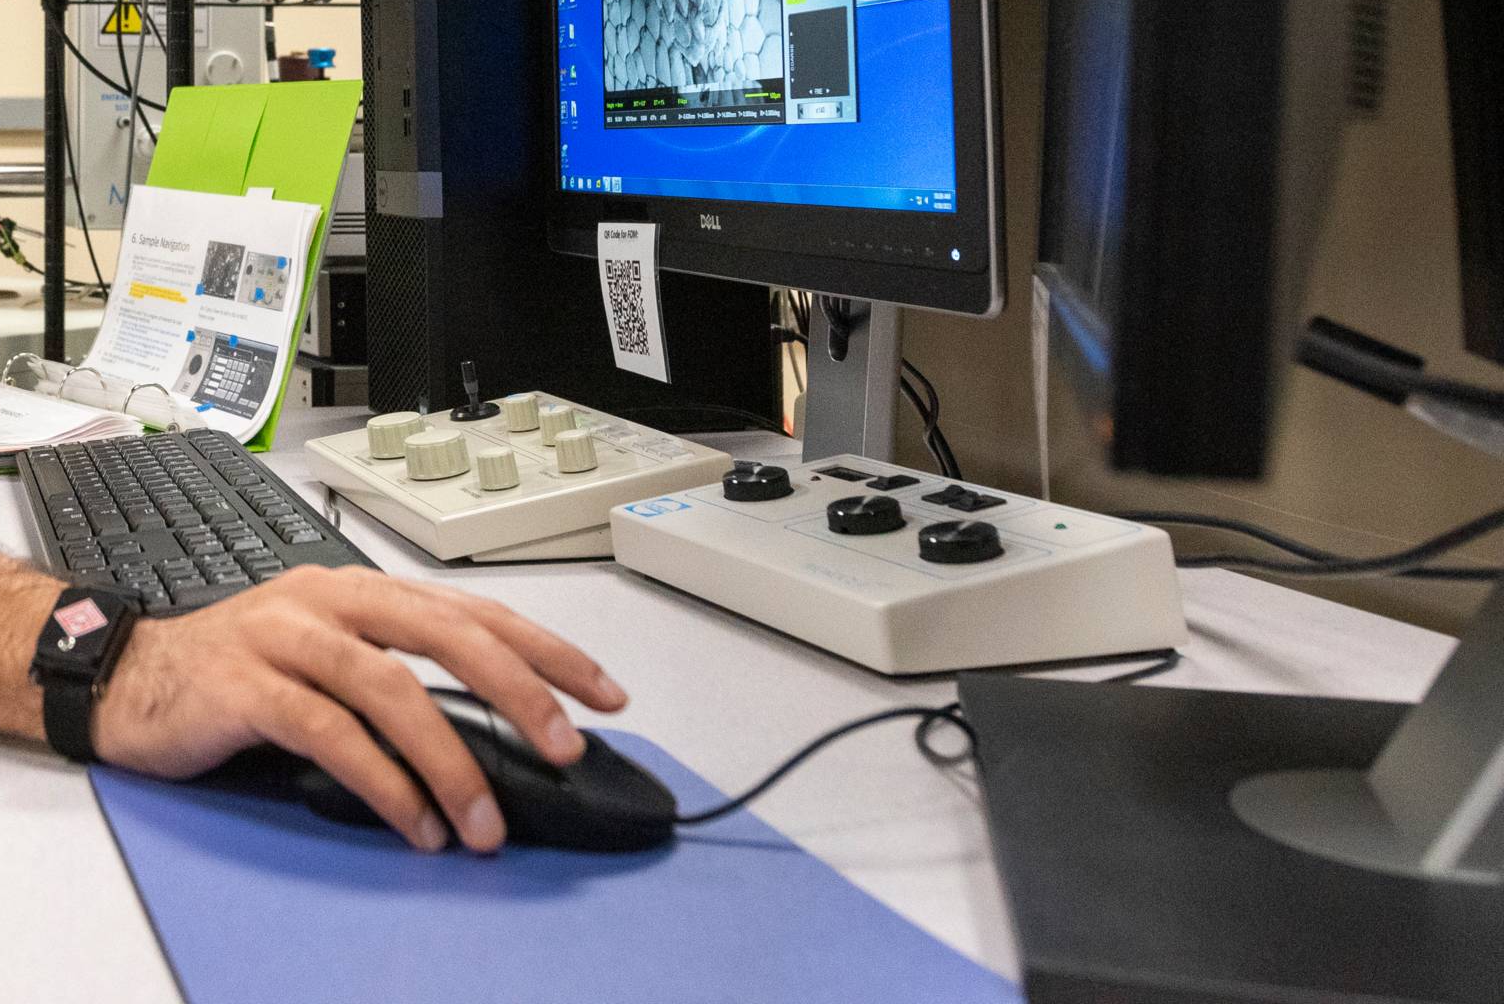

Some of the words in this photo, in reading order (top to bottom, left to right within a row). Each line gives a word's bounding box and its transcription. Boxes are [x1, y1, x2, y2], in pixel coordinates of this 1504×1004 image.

[700, 213, 722, 231] DELL
[131, 232, 138, 245] 6.
[139, 234, 160, 248] Sample
[160, 237, 191, 253] Navigation
[603, 230, 610, 240] QR
[610, 230, 621, 240] Code
